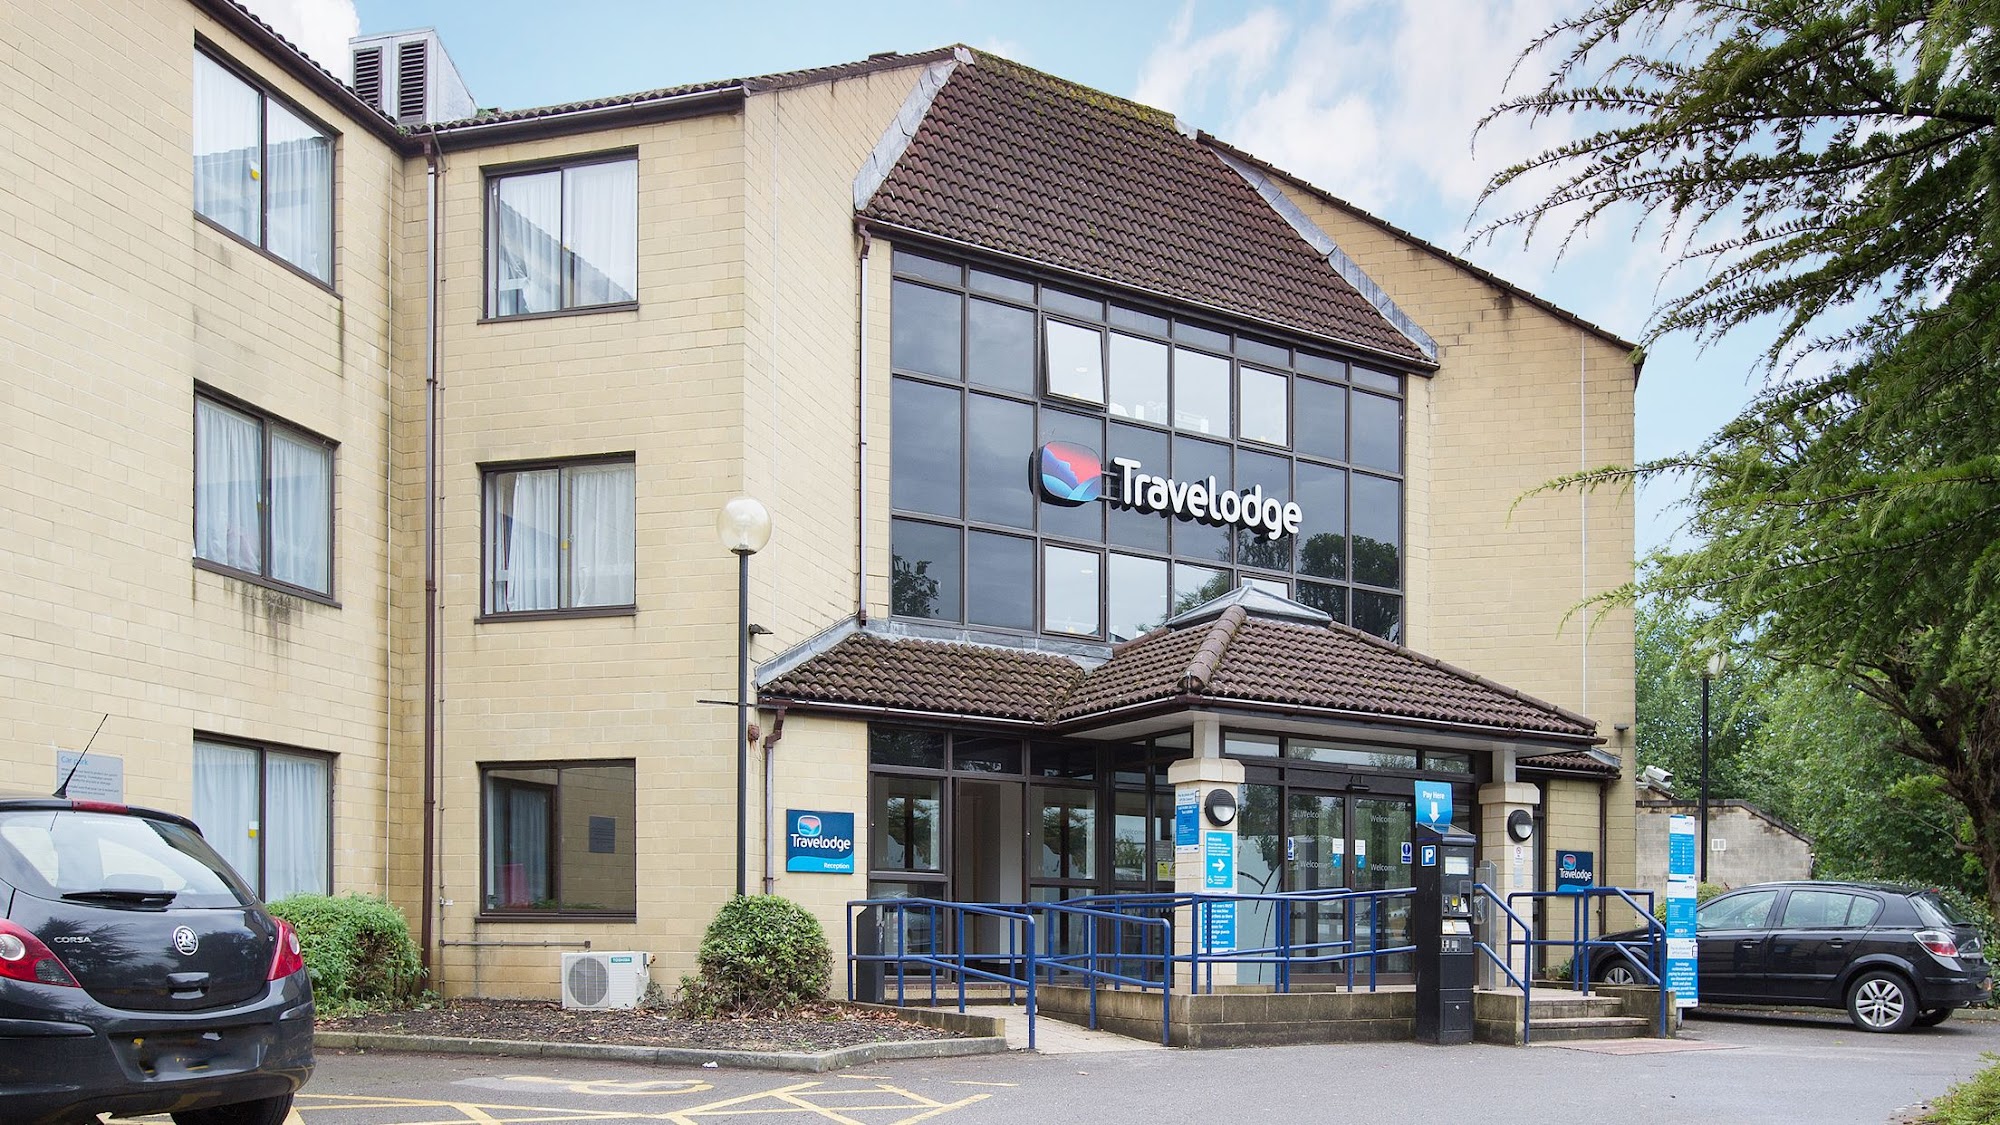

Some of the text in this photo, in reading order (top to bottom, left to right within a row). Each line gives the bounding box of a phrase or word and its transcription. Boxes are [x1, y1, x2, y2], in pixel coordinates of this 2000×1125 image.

[1114, 456, 1303, 540] Travelodge
[74, 758, 88, 766] prk
[1422, 790, 1446, 800] Pay Here
[1371, 815, 1397, 824] Welcome
[790, 834, 851, 852] Travelodge
[1425, 849, 1434, 863] P
[823, 862, 850, 870] Reception
[1371, 863, 1397, 872] Welcome
[1559, 868, 1593, 881] Travelodge
[54, 936, 92, 944] CORSA
